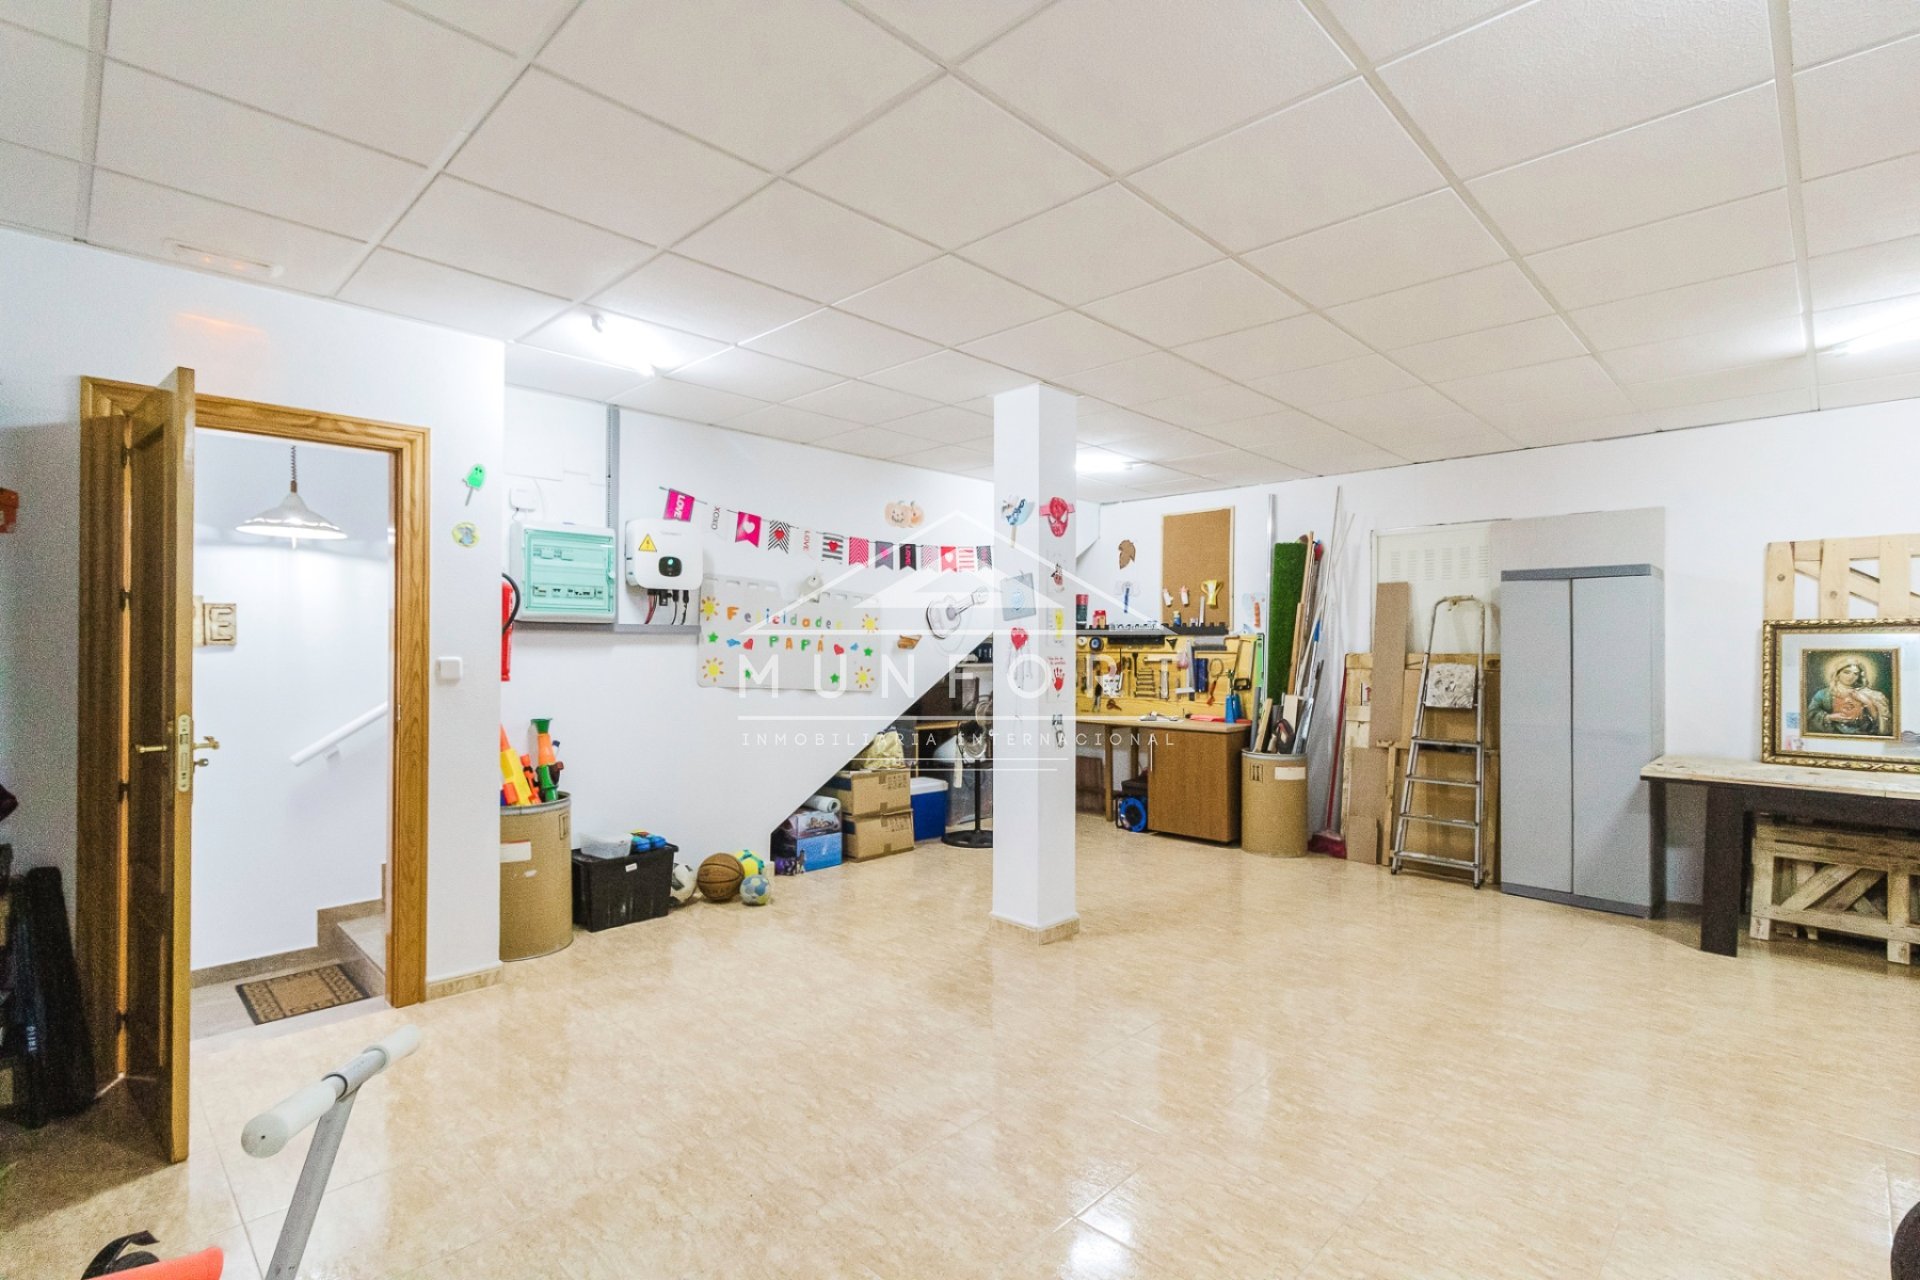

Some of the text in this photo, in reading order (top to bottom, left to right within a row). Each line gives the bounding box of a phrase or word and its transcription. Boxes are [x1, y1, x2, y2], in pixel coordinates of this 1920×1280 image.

[673, 494, 686, 519] LOVE
[711, 505, 721, 530] XOXO
[802, 530, 811, 551] LOVE
[904, 543, 912, 566] LOVE
[768, 634, 824, 653] PAPÁ
